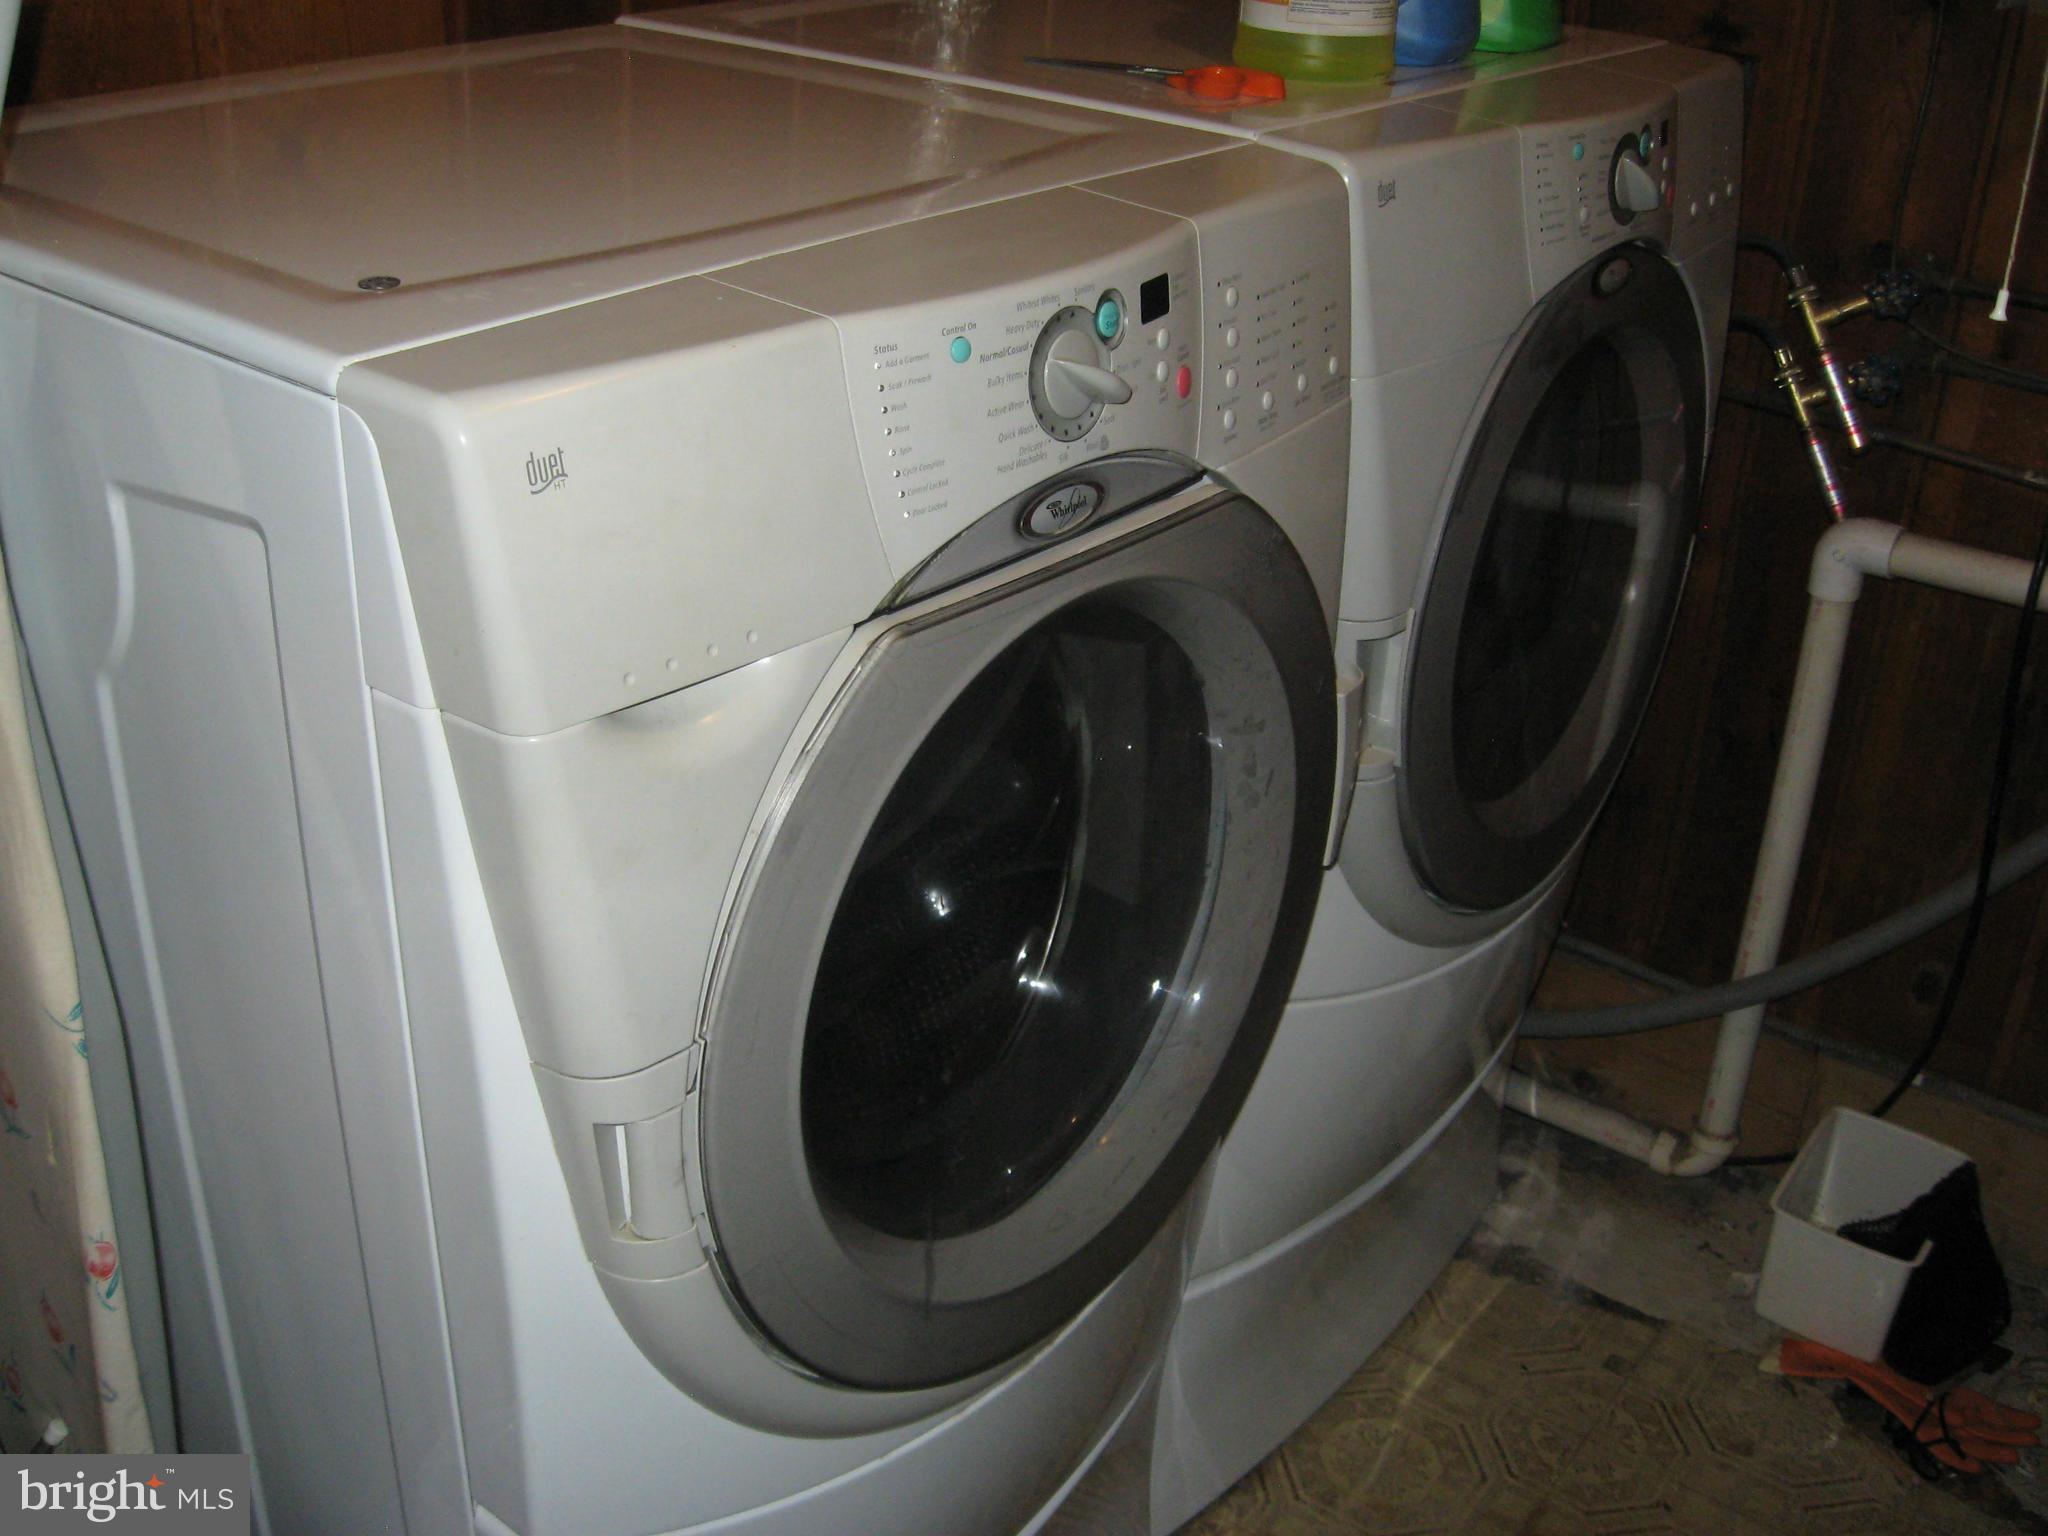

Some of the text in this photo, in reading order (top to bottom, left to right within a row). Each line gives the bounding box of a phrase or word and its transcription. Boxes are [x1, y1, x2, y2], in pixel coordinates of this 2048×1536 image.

[941, 322, 977, 337] Control On
[1006, 319, 1041, 335] Heavy Duty
[873, 343, 898, 355] Status
[885, 359, 898, 369] Add
[998, 428, 1017, 444] Quick
[526, 446, 567, 488] duet
